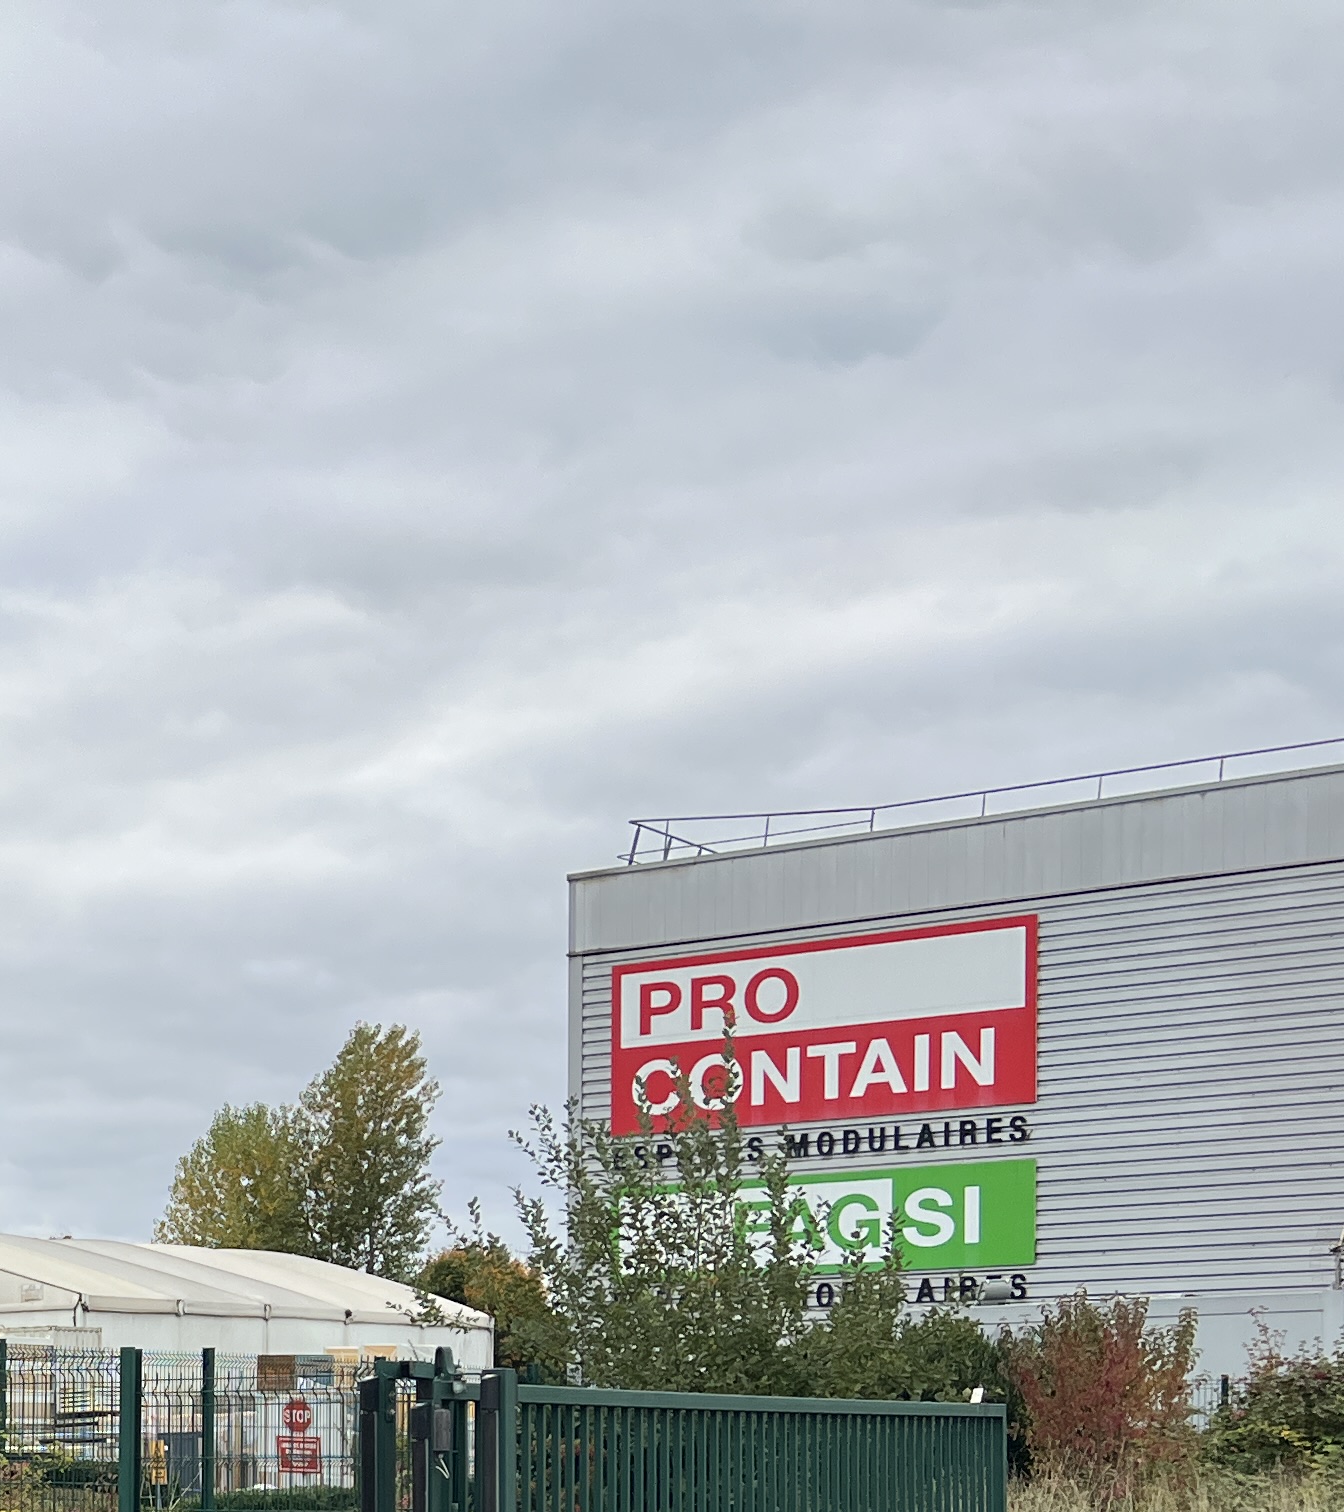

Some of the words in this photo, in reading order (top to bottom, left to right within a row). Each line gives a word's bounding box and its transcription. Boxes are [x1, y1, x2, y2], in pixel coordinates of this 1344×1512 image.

[639, 967, 800, 1036] PRO
[631, 1026, 996, 1116] CONTAIN
[614, 1136, 763, 1172] ESPS
[785, 1115, 1029, 1159] MODULAIRES
[283, 1409, 311, 1423] STOP
